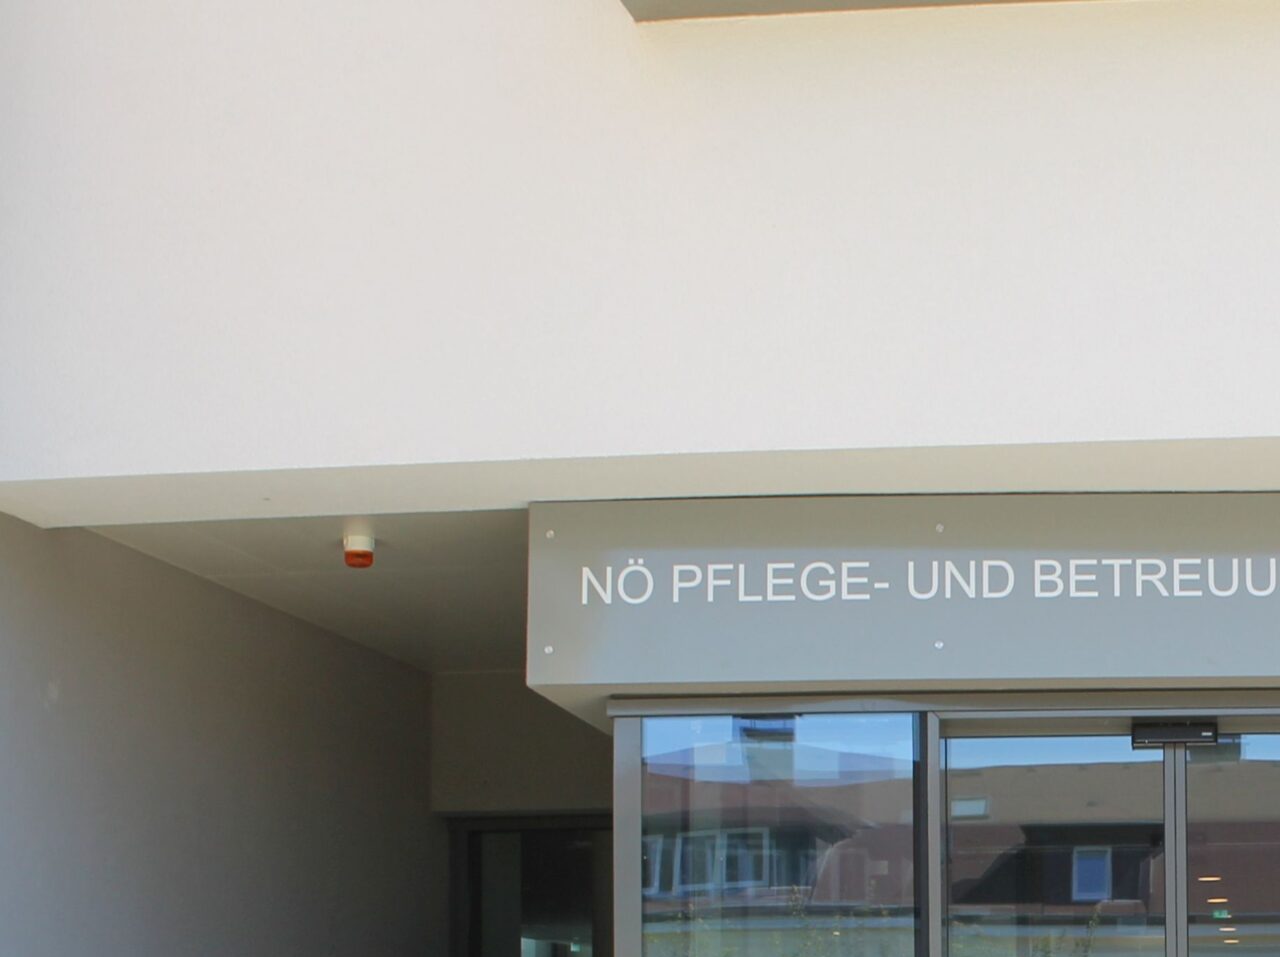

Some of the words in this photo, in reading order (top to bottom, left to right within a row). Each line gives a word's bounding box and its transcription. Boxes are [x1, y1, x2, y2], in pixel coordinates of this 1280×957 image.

[581, 557, 654, 605] NÖ
[672, 561, 891, 603] PFLEGE-
[907, 559, 1015, 600] UND
